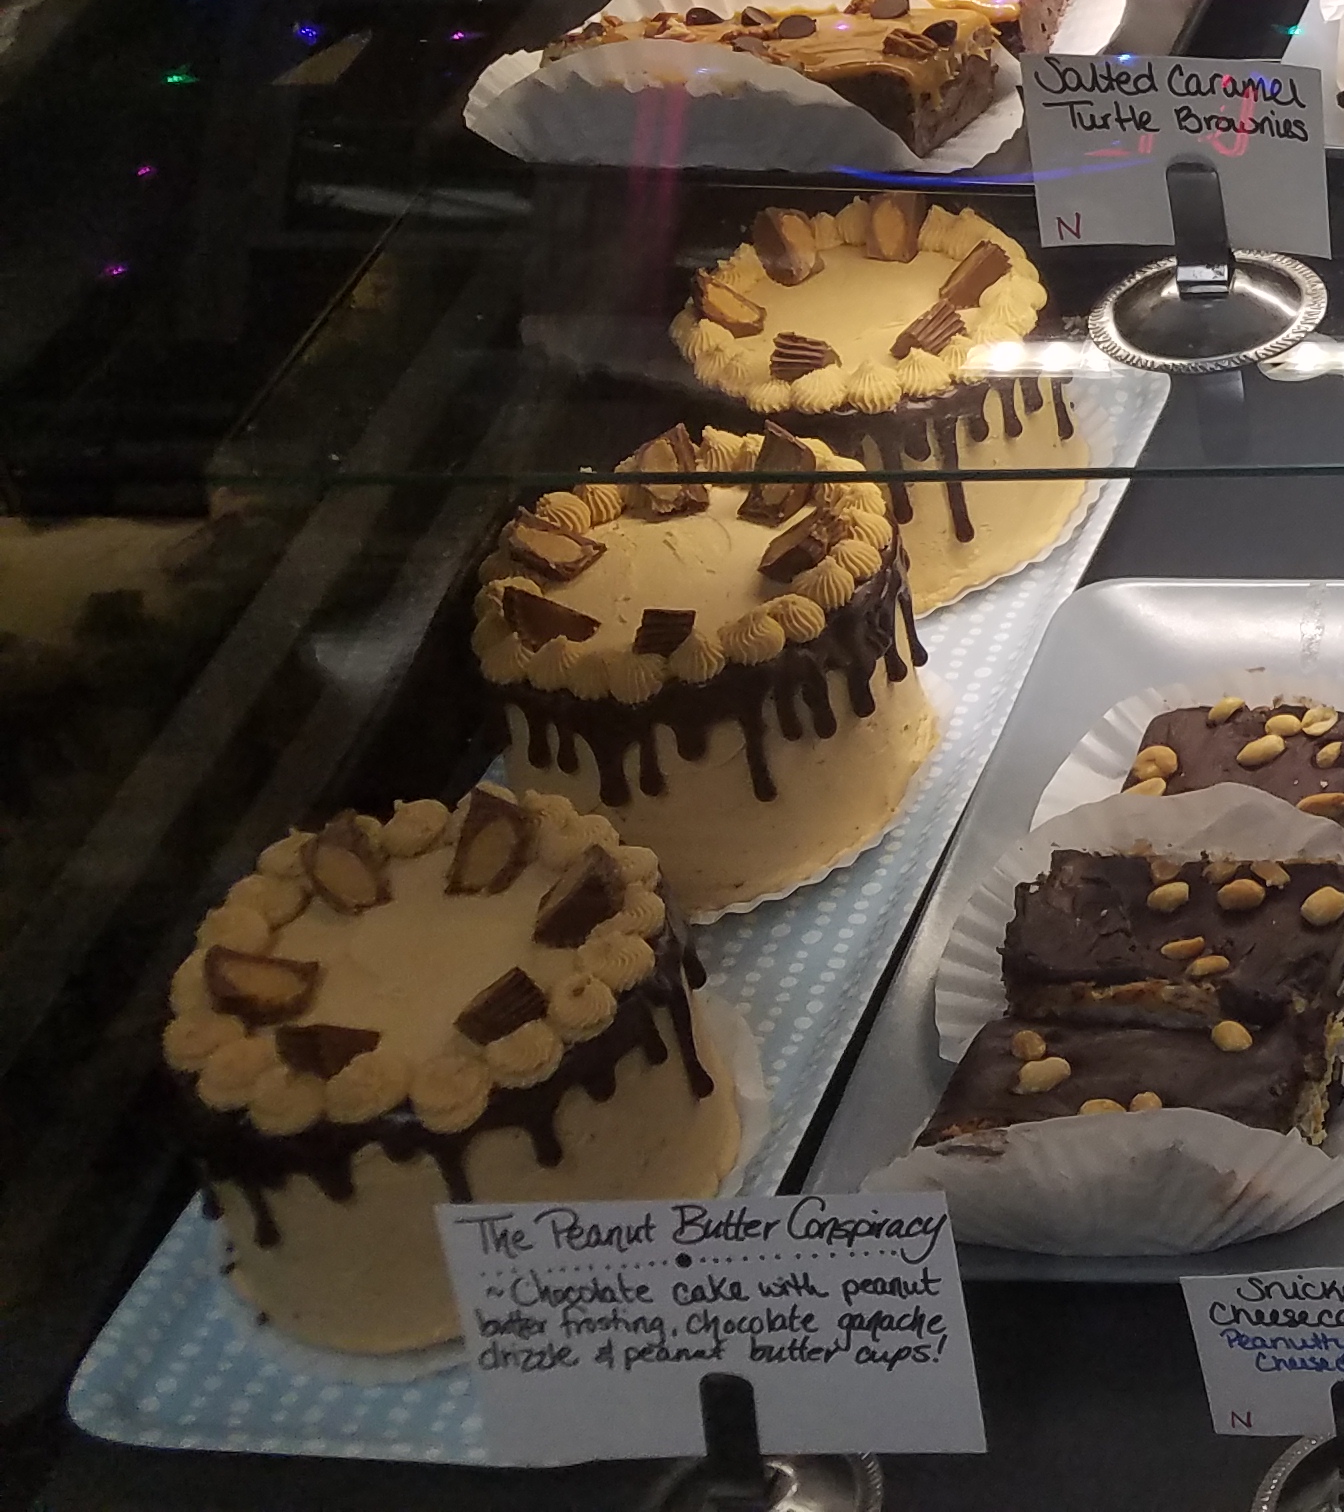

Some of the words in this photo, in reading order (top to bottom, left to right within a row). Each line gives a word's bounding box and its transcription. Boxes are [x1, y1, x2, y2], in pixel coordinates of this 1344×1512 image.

[1034, 56, 1158, 96] Salted
[1167, 63, 1307, 109] Caramel
[1042, 99, 1161, 132] Turtle
[1173, 104, 1309, 142] Brownies
[1056, 211, 1082, 241] N
[454, 1212, 534, 1260] The
[534, 1206, 657, 1253] Peanut
[671, 1204, 781, 1245] Butter
[786, 1195, 947, 1265] Conspiracy
[671, 1274, 750, 1307] cake
[757, 1271, 830, 1299] with
[841, 1266, 941, 1307] peanut
[836, 1305, 948, 1351] ganache
[624, 1338, 728, 1371] peanut
[750, 1335, 838, 1363] butter
[854, 1334, 948, 1372] cups!
[1230, 1411, 1253, 1429] N
